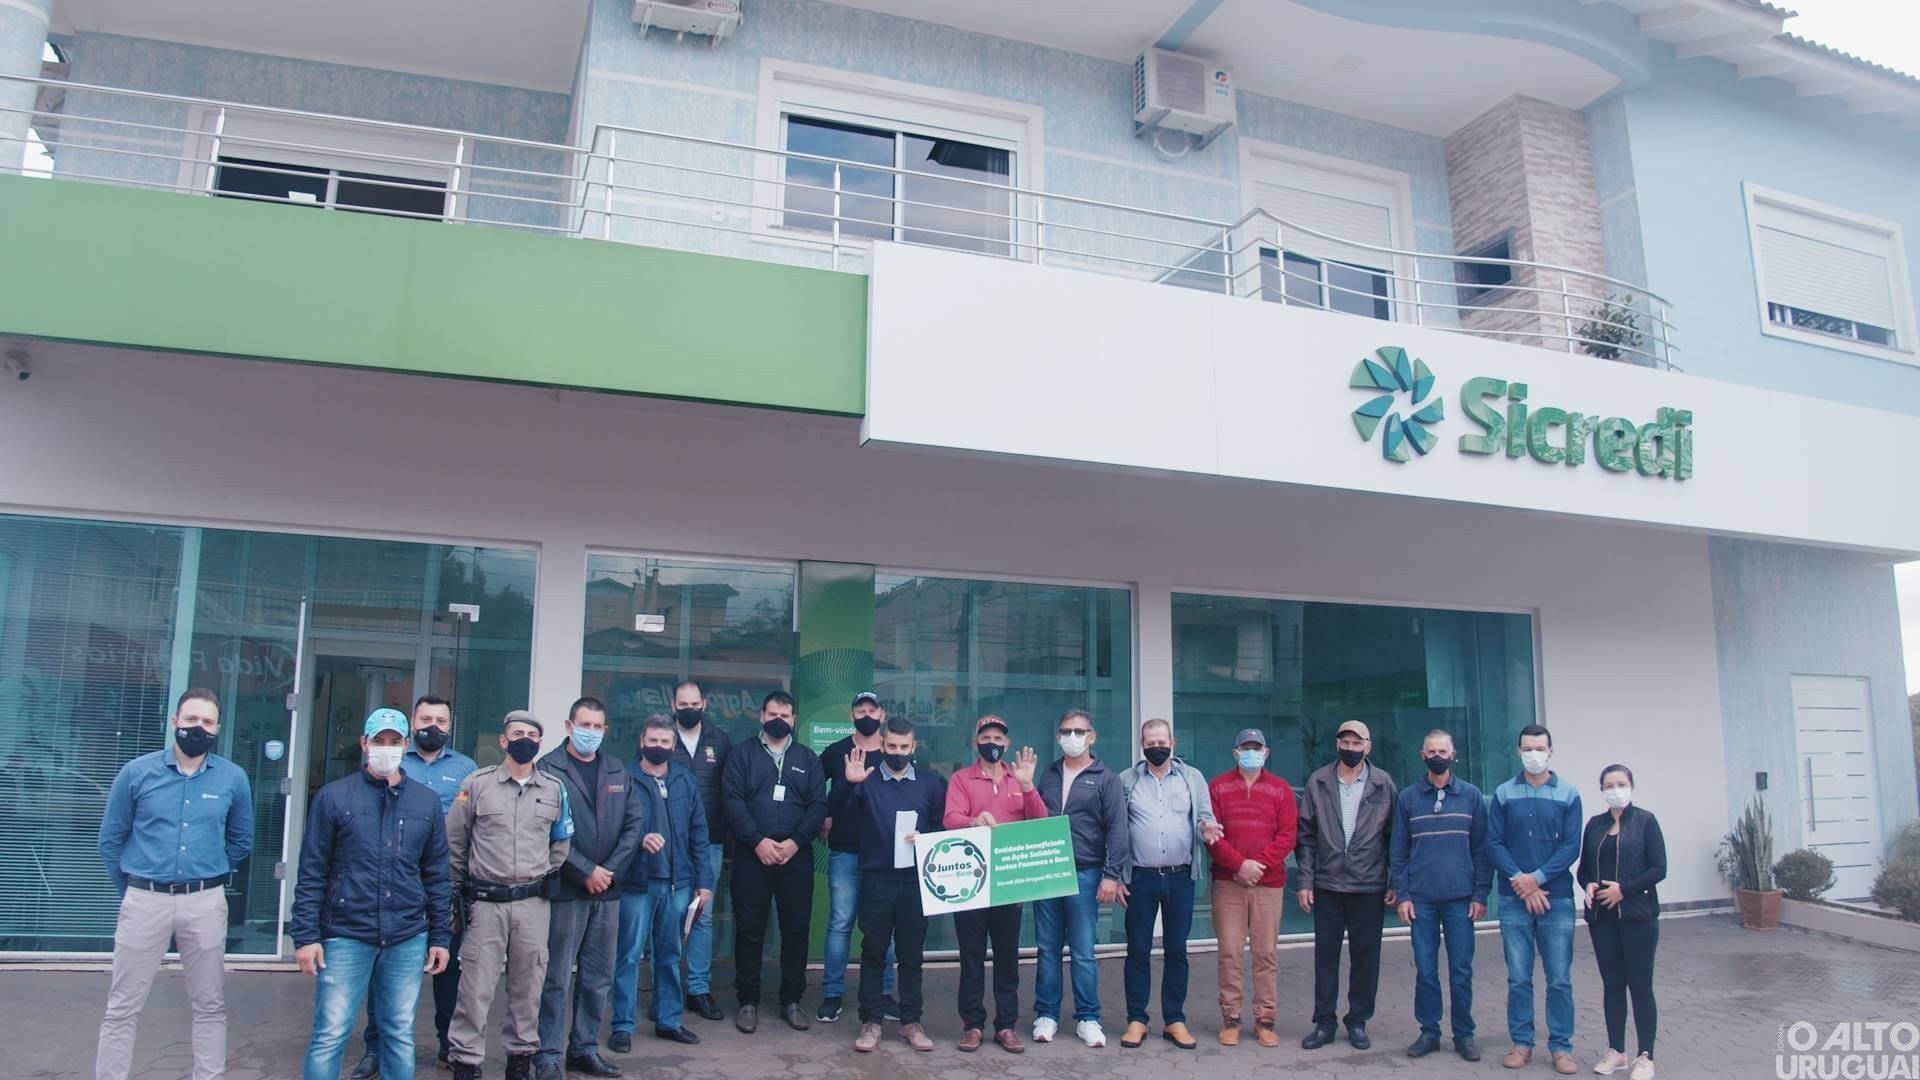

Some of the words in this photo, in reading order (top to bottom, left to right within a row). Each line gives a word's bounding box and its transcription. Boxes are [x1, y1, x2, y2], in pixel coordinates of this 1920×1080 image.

[1459, 376, 1692, 480] Sicredi
[994, 844, 1025, 855] Entidade
[1011, 852, 1029, 862] Ação
[937, 862, 972, 872] Juntos
[995, 863, 1018, 871] Juntos
[1018, 859, 1048, 868] Fazemos
